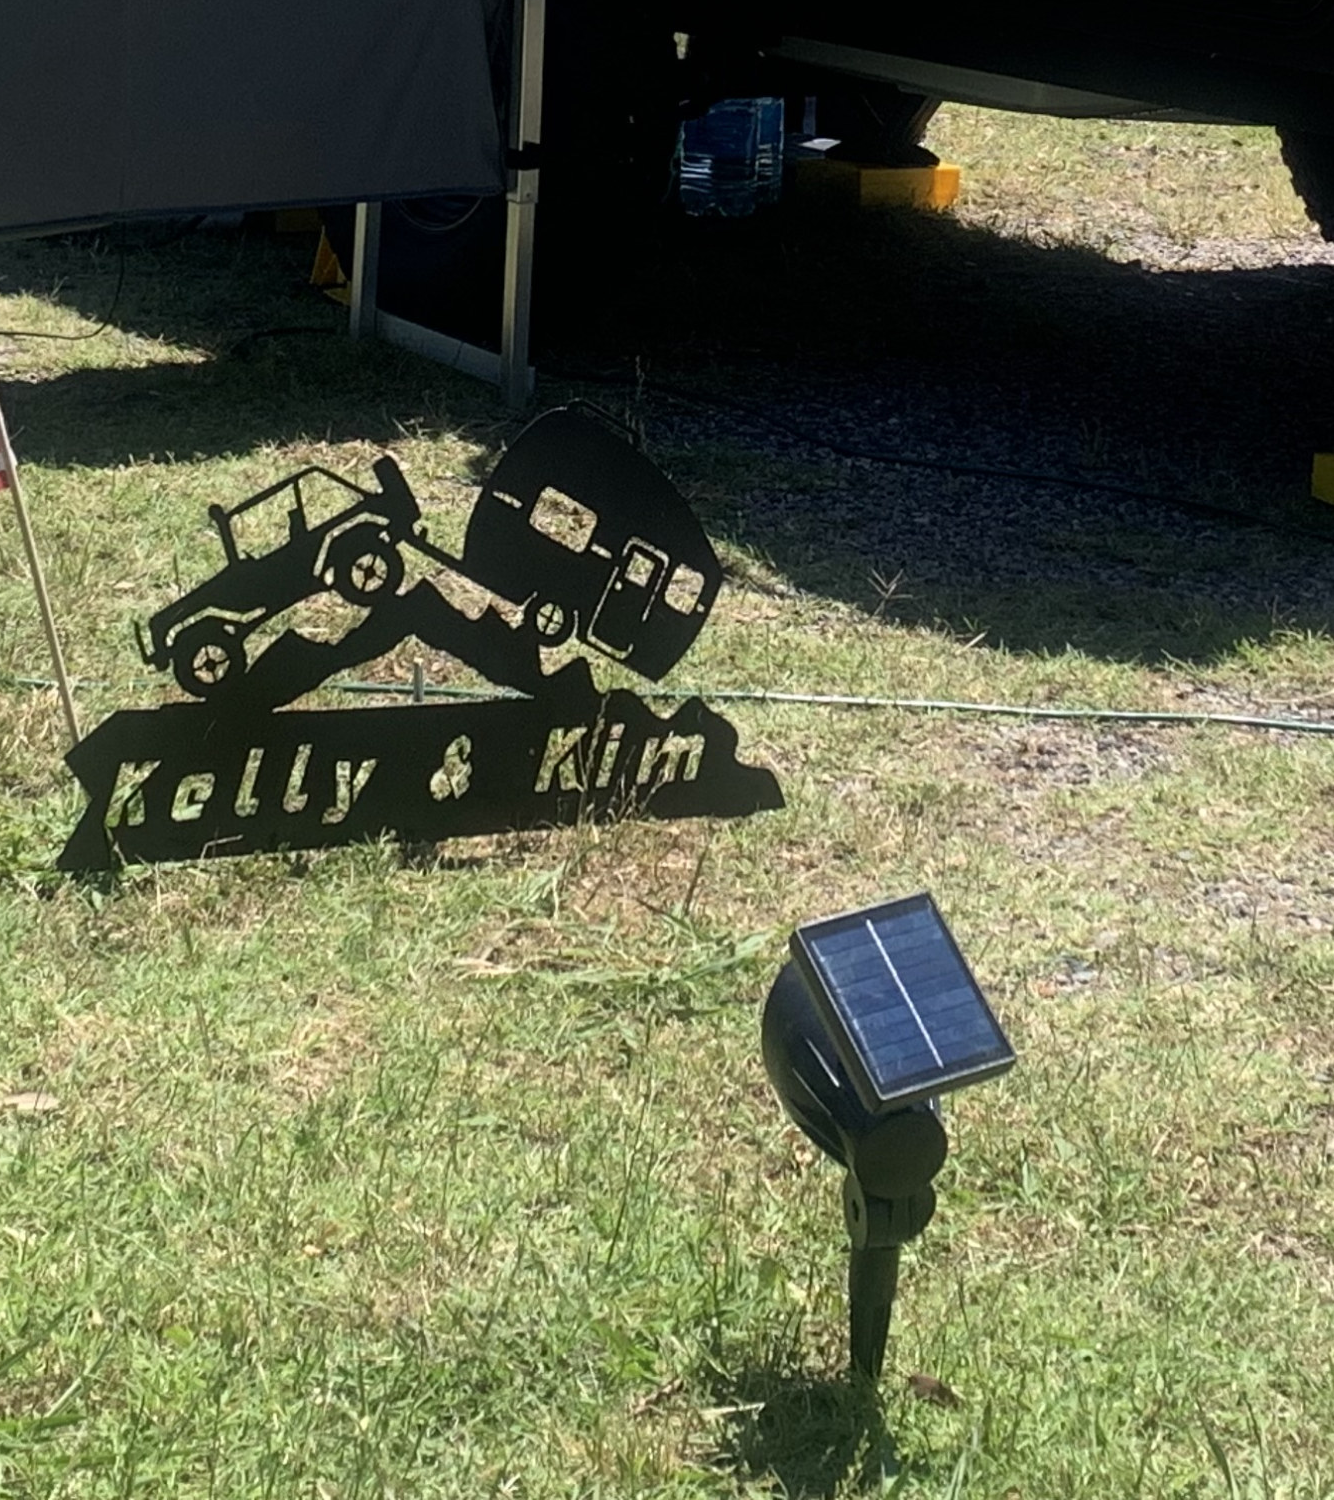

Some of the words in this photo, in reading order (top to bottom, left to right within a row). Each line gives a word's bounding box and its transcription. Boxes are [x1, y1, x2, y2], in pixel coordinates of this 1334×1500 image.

[104, 743, 378, 828] Kelly
[429, 734, 472, 803] &
[534, 722, 706, 794] Kim
